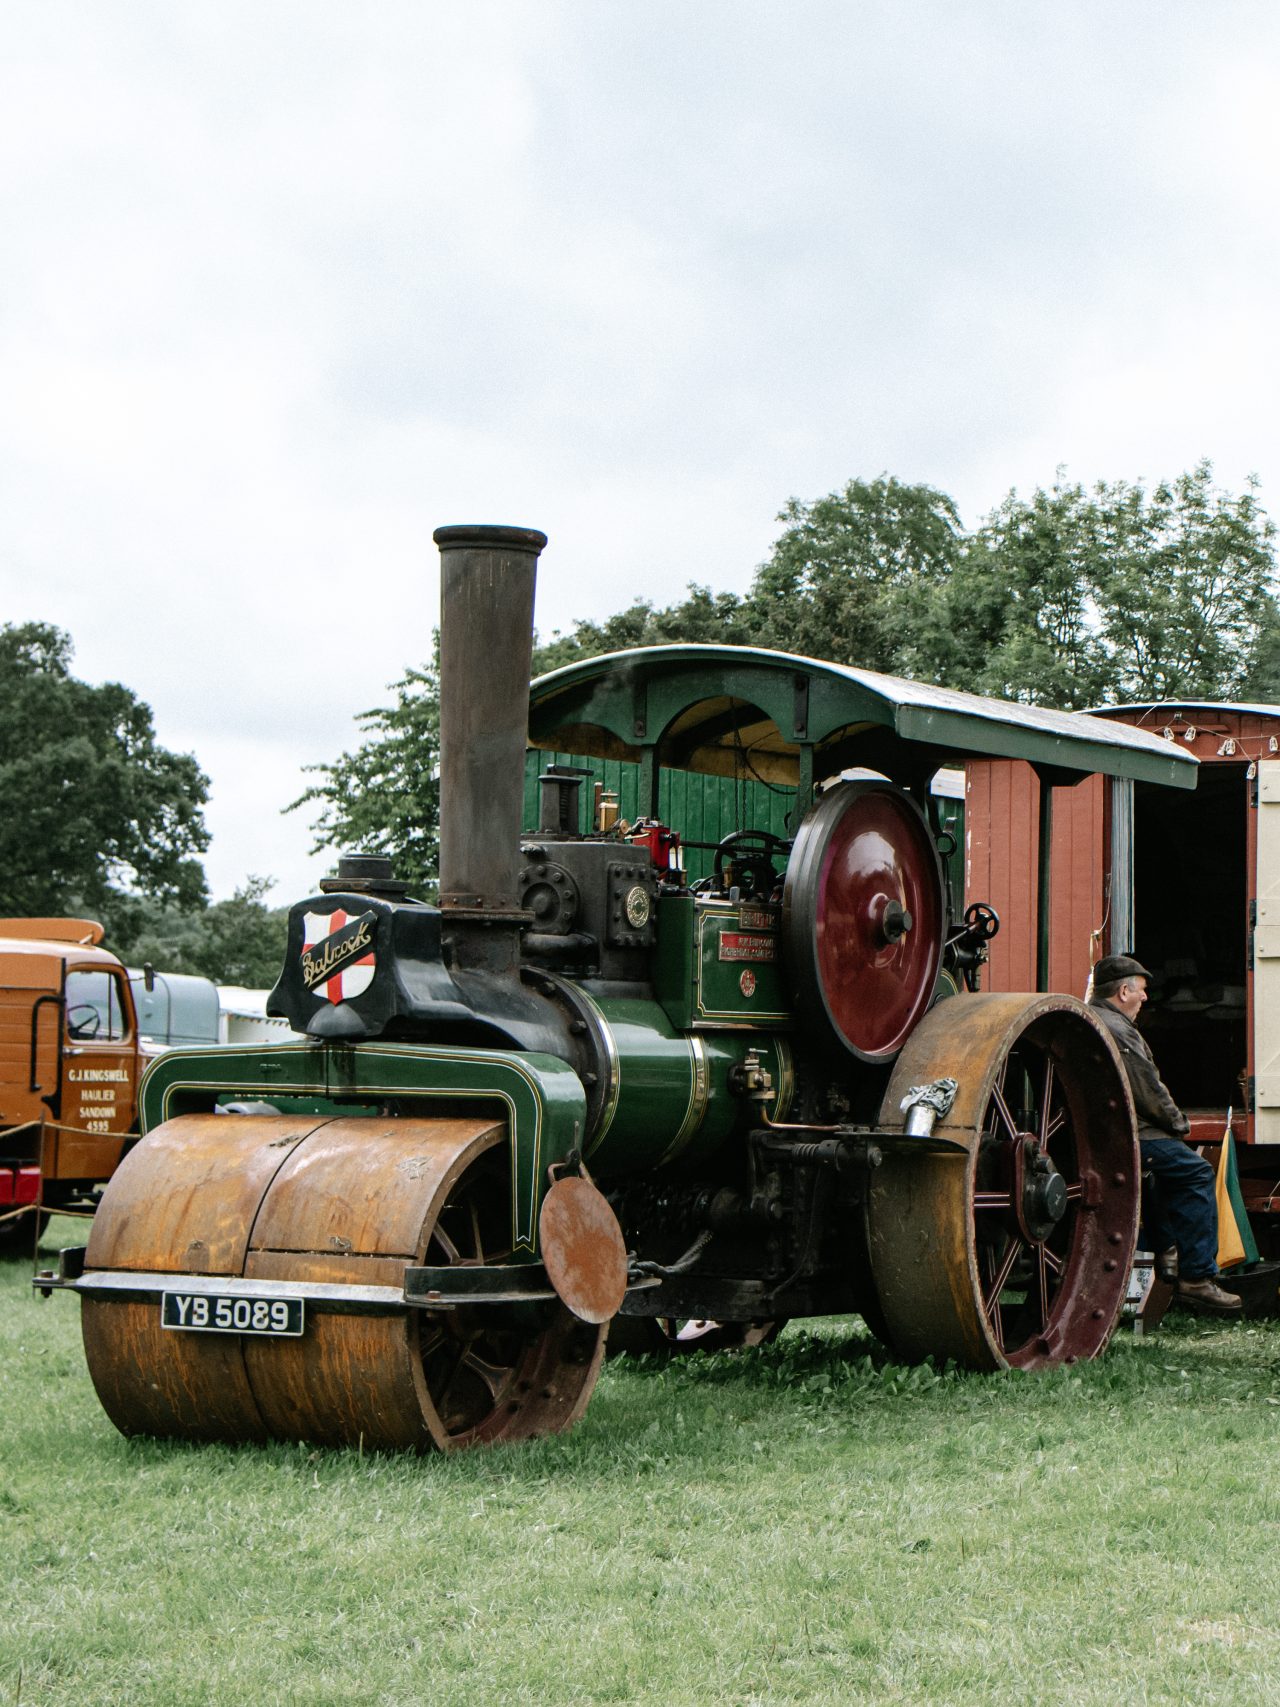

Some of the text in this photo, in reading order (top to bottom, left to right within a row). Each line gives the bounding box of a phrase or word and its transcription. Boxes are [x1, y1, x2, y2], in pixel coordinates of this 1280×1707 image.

[81, 1089, 115, 1101] HAULIER
[79, 1106, 116, 1118] SANDOWN
[86, 1120, 109, 1132] 4595
[175, 1296, 289, 1331] YB 5089
